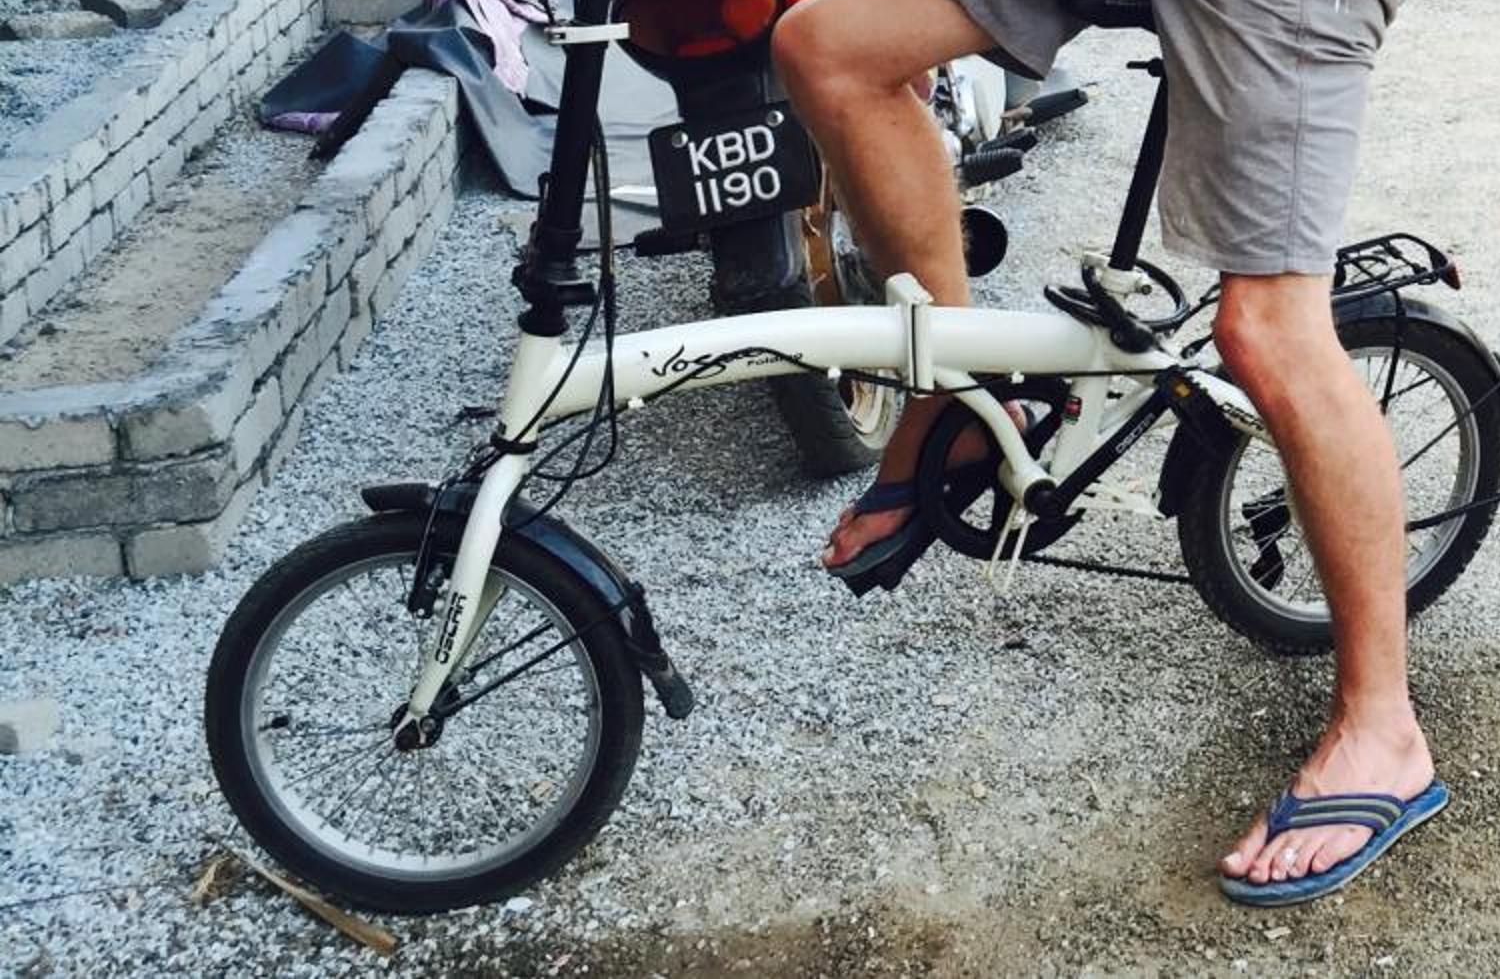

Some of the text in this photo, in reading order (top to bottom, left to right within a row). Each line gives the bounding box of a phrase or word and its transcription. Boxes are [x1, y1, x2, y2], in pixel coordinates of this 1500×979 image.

[688, 125, 775, 176] KBD
[694, 165, 781, 216] 1190
[435, 592, 467, 664] OSCAR
